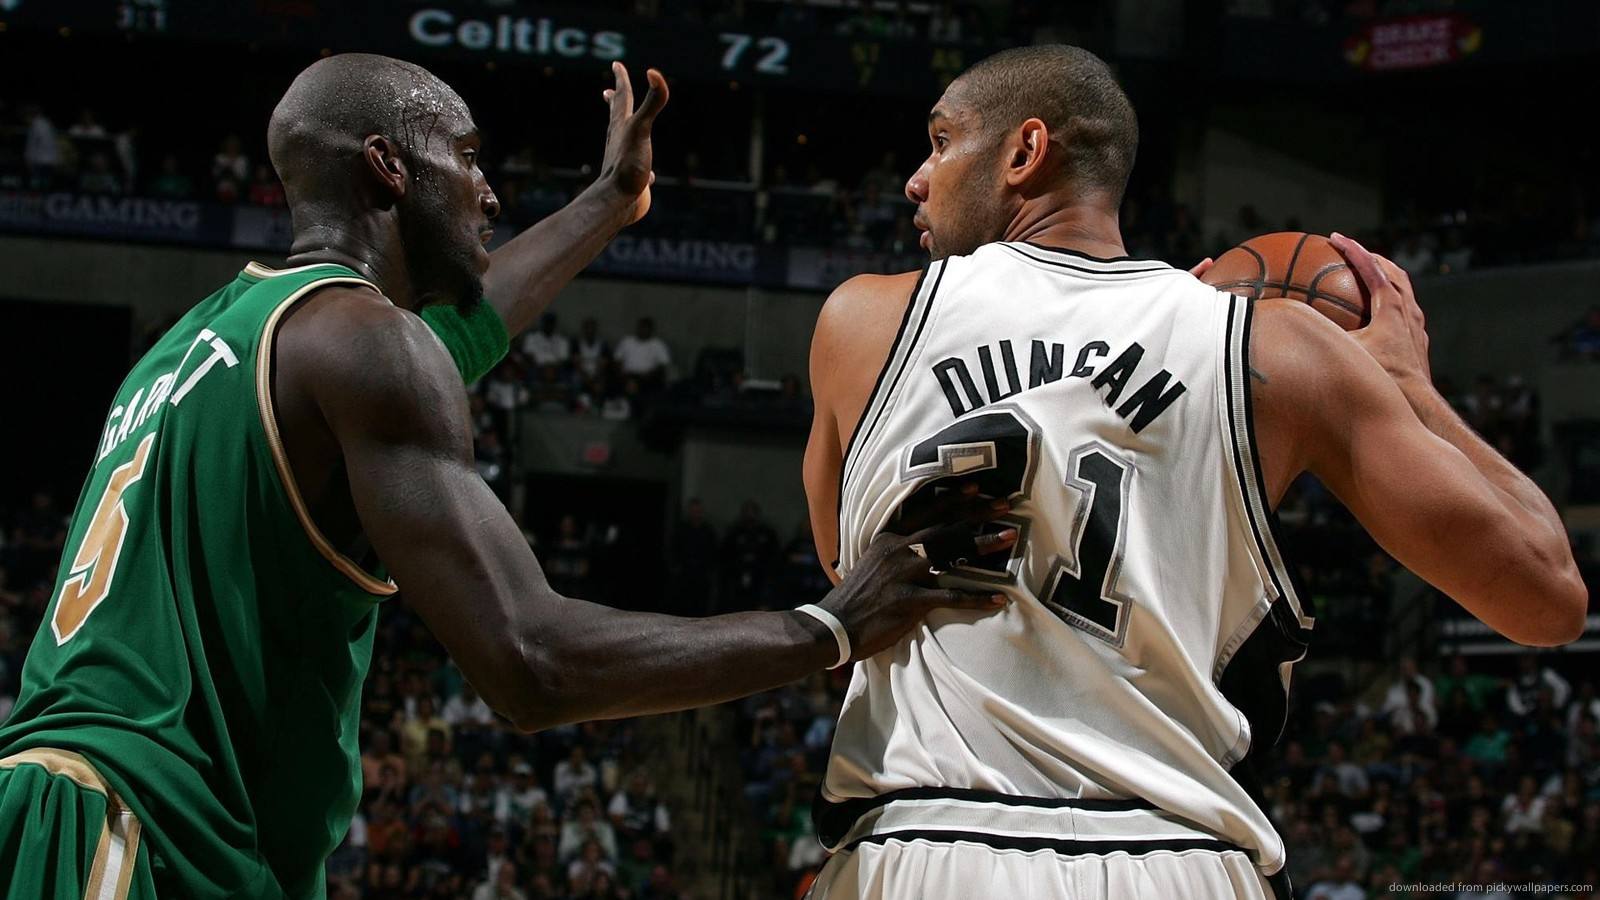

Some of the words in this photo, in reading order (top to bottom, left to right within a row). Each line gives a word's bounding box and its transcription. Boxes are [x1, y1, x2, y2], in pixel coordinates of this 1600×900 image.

[407, 8, 626, 60] Celtics
[717, 32, 791, 76] 72
[44, 191, 199, 229] GAMING
[608, 234, 757, 271] GAMING
[95, 328, 240, 469] GART
[931, 339, 1187, 434] DUNCAN
[51, 431, 157, 647] 5
[900, 402, 1136, 649] 21
